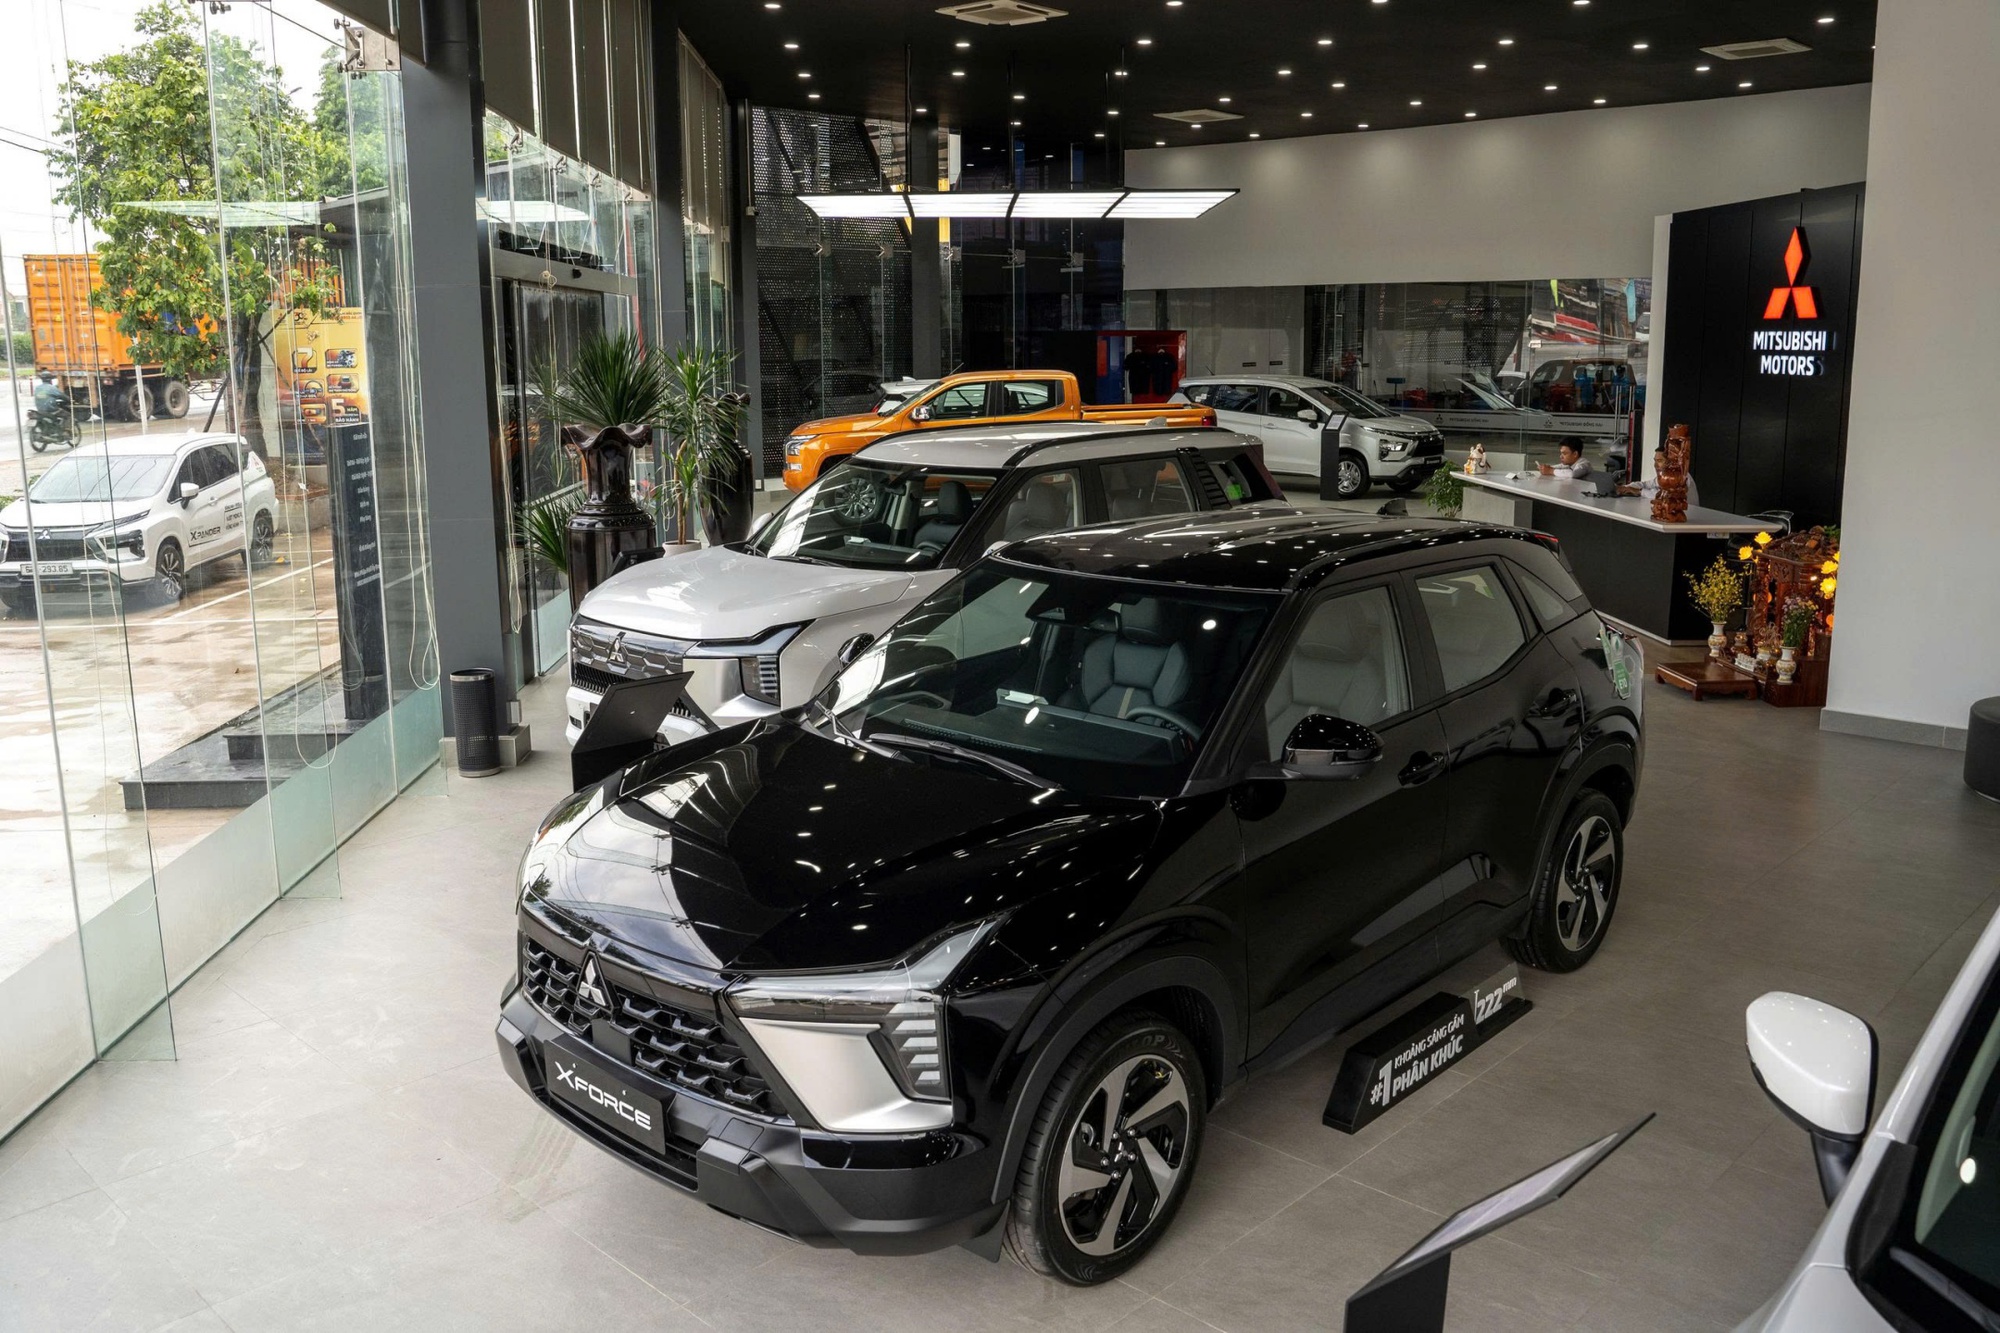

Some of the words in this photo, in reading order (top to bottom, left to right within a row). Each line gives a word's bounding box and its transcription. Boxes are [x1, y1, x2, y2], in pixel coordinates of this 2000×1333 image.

[1753, 330, 1826, 351] MITSUBISHI
[297, 347, 313, 368] 7
[1760, 355, 1815, 377] MOTORS
[331, 398, 346, 417] 5
[190, 526, 221, 541] XPANDER
[1426, 1025, 1447, 1048] SÁNG
[1392, 1057, 1429, 1097] PHÂN
[1430, 1034, 1464, 1072] KHÚC
[554, 1061, 652, 1131] XFORCE
